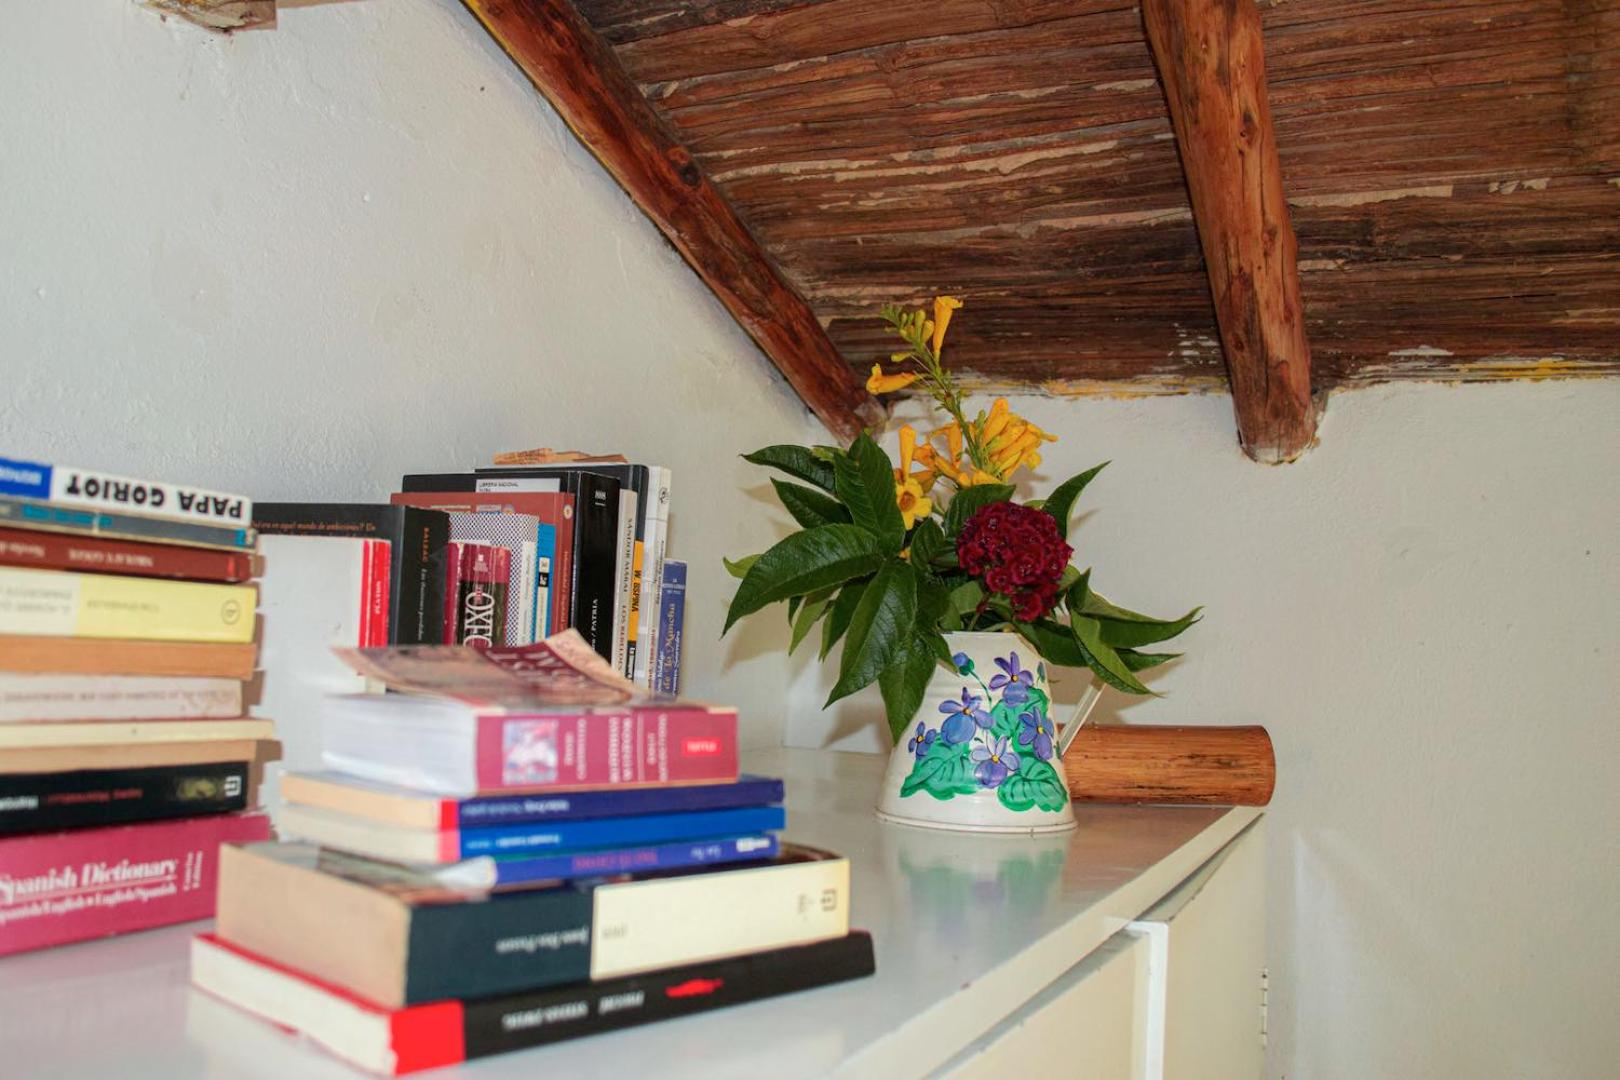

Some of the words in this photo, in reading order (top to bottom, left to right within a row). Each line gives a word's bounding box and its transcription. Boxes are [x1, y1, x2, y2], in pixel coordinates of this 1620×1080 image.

[66, 475, 164, 507] GORIOT
[179, 492, 243, 518] PAPA
[463, 592, 495, 648] OXFO
[664, 603, 676, 653] Mancha
[0, 865, 77, 904] Spanish
[81, 858, 178, 886] Dictionary
